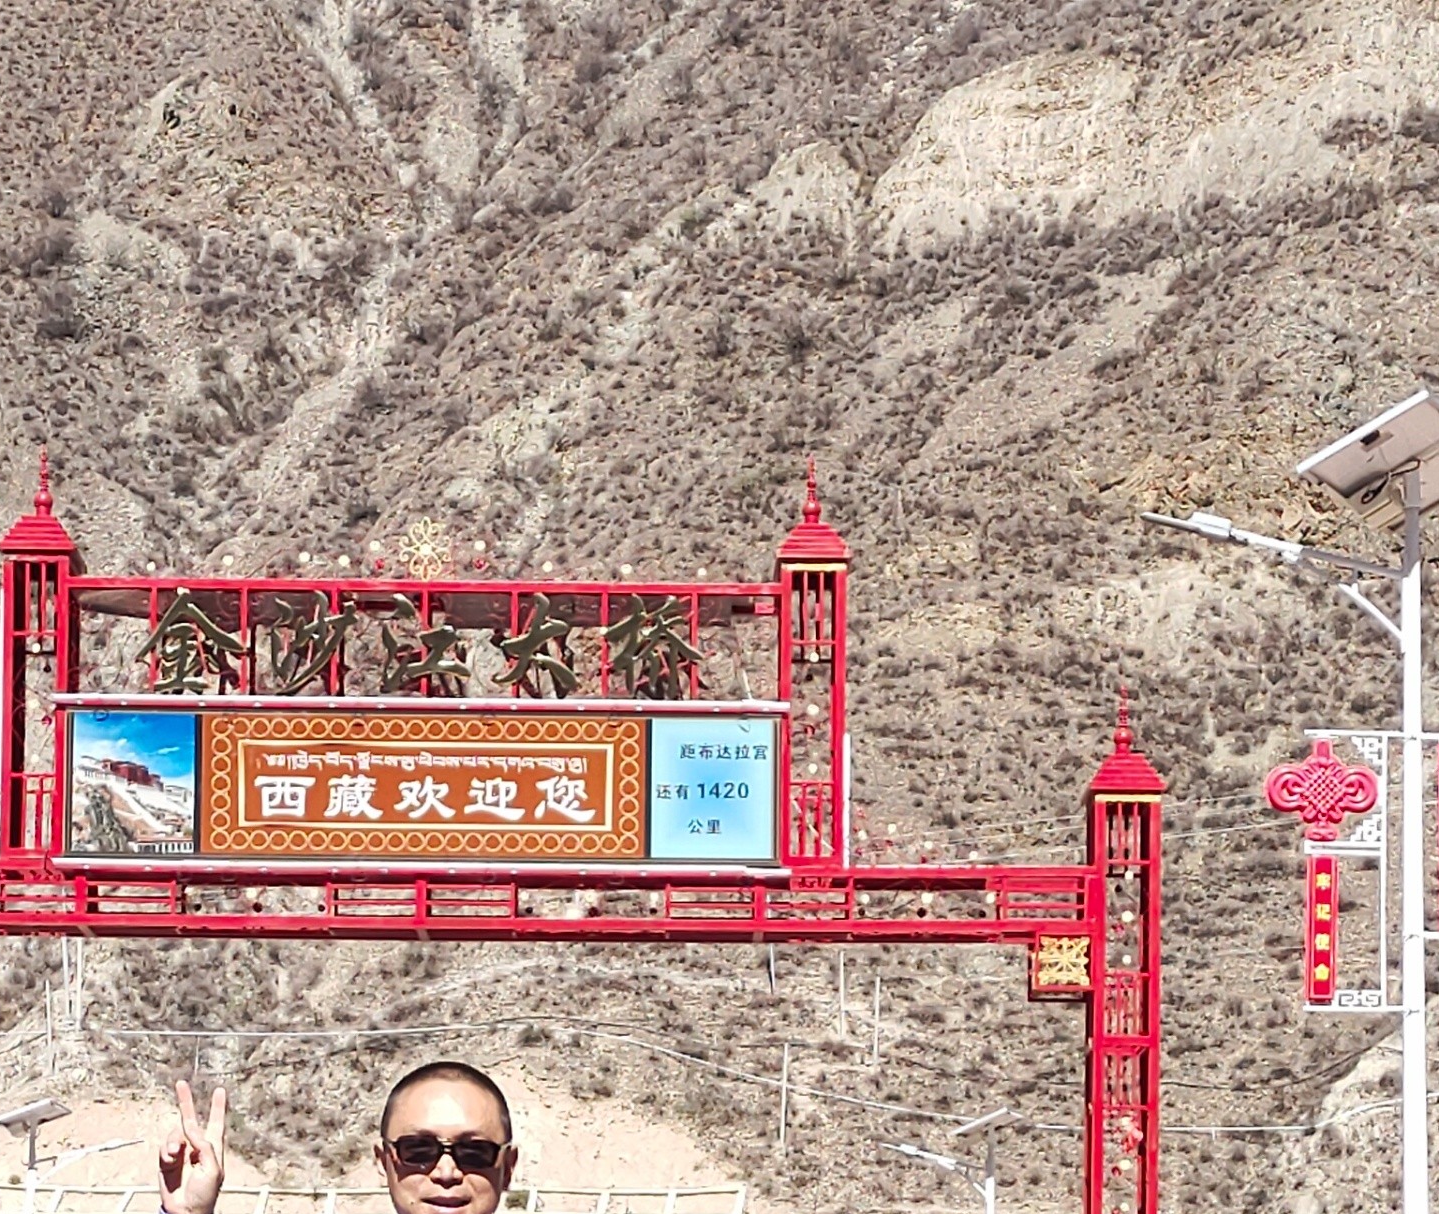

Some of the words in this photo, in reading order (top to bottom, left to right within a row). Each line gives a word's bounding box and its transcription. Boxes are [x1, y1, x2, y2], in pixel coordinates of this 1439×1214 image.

[138, 590, 704, 699] 金沙江大桥
[680, 743, 768, 760] 距布达拉宫
[254, 774, 596, 823] 西藏欢迎您
[656, 784, 689, 799] 还有
[697, 782, 749, 799] 1420
[688, 819, 721, 834] 公里
